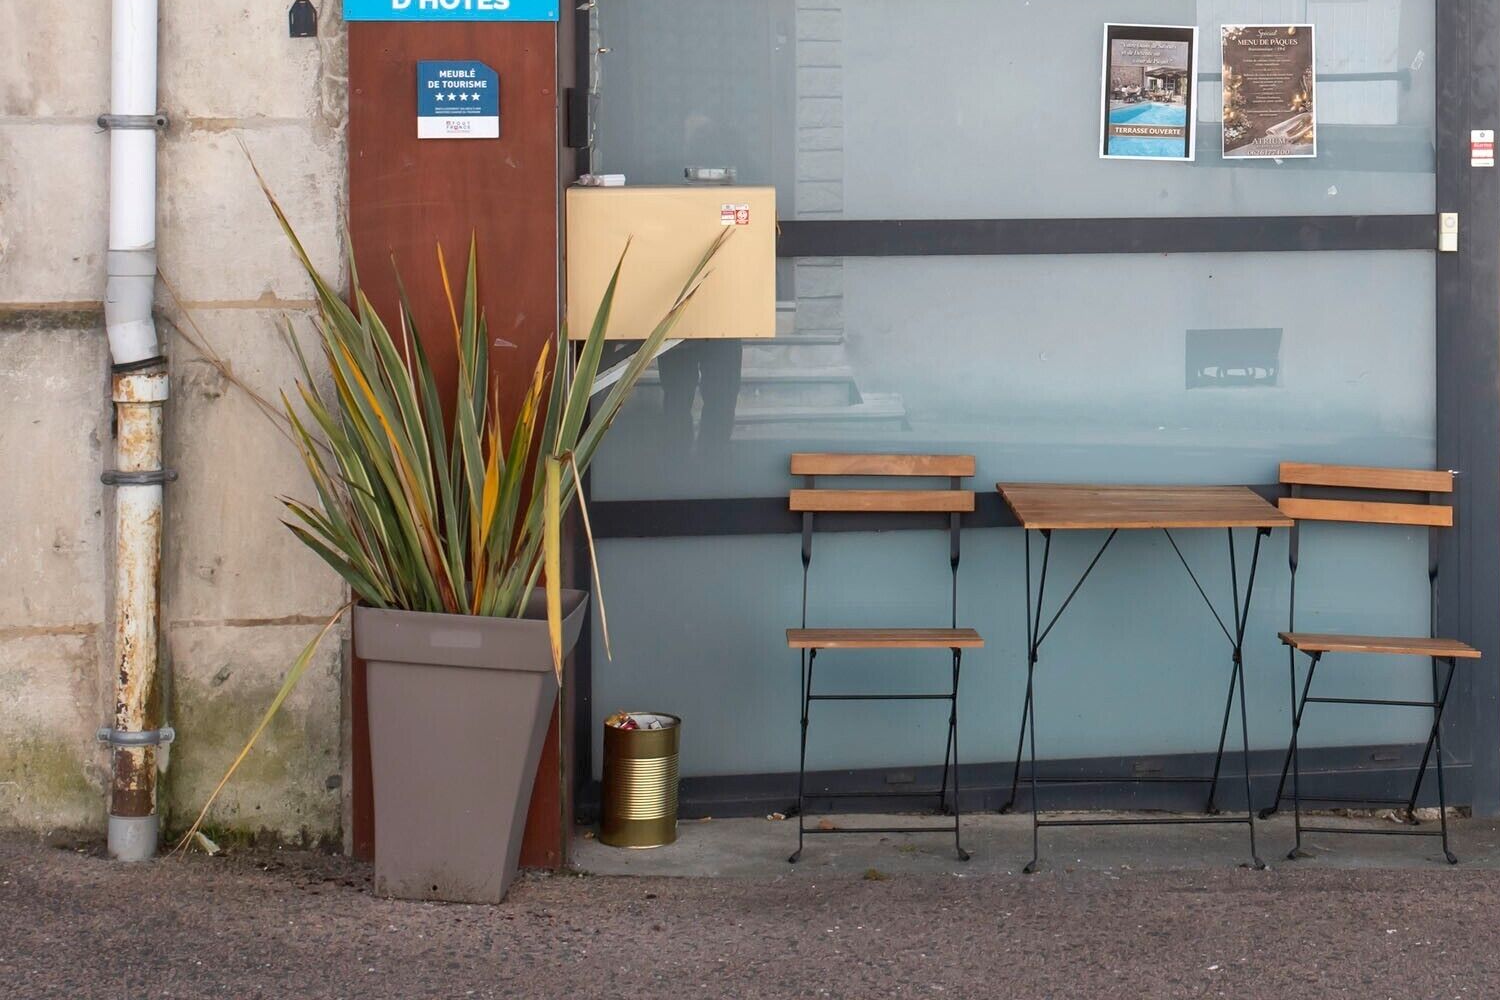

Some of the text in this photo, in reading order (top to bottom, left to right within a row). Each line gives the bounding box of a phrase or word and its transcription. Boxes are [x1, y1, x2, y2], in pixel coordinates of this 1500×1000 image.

[1270, 38, 1298, 47] PÂQUES
[439, 67, 476, 78] MEUBLÉ
[427, 80, 488, 89] DE TOURISME
[1115, 126, 1181, 136] TERRASSE OUVERTE
[1251, 137, 1287, 145] ATRIUM
